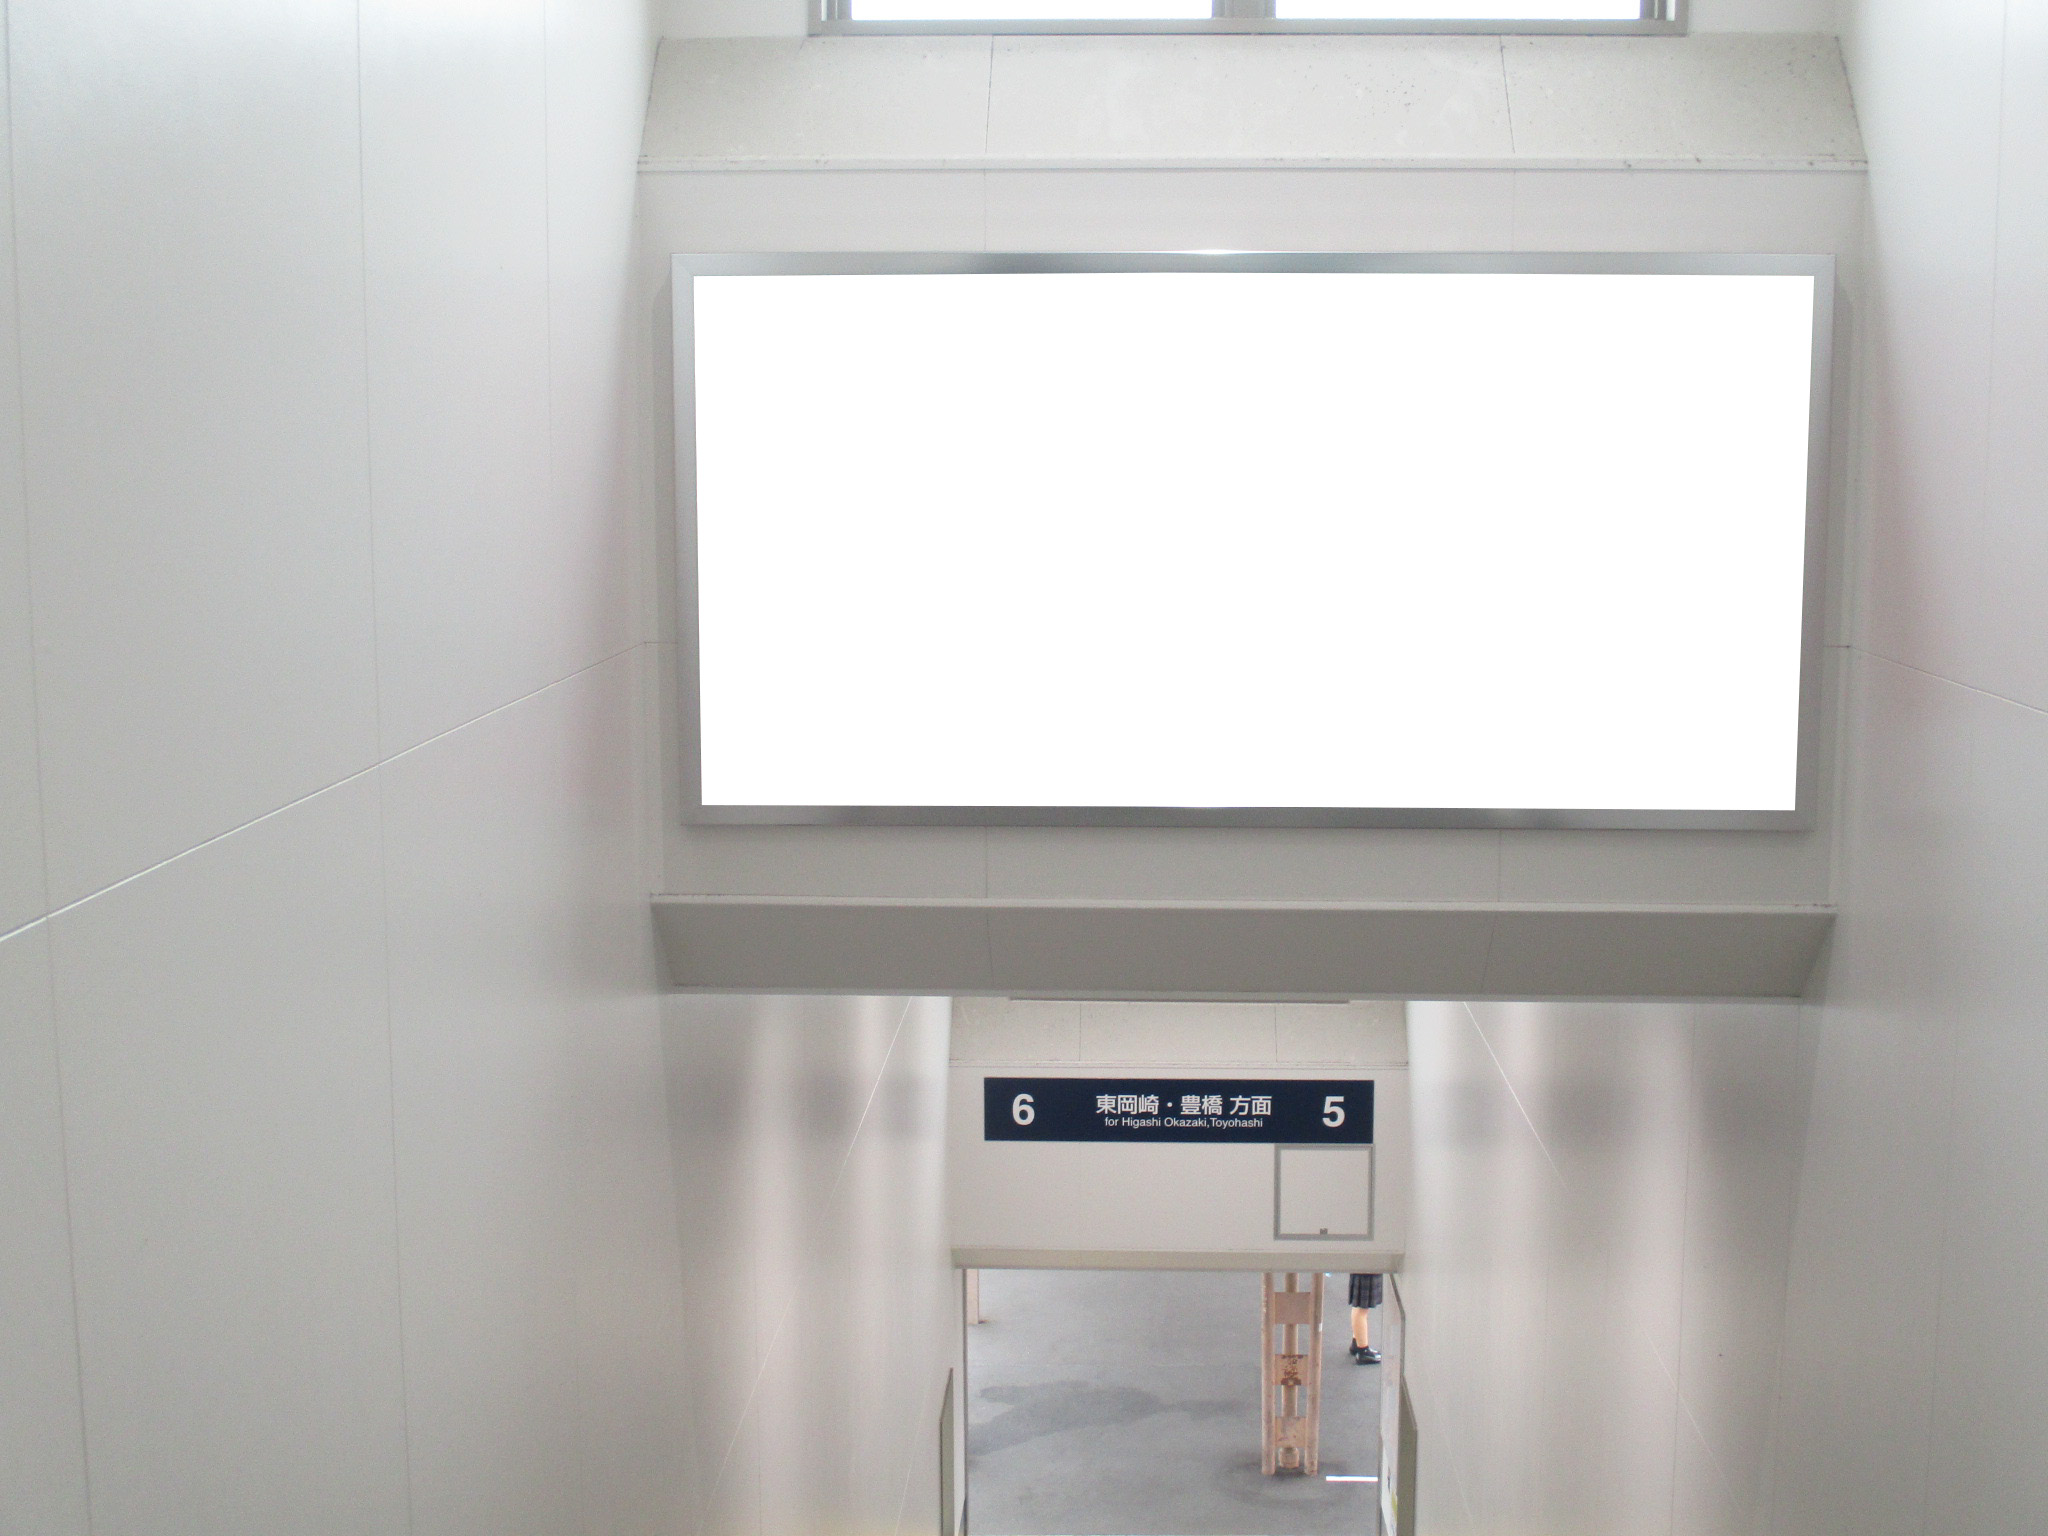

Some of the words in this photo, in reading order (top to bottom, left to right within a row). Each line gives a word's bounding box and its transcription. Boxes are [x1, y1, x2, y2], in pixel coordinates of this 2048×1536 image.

[1012, 1093, 1035, 1126] 6
[1230, 1095, 1272, 1116] 方面
[1322, 1095, 1346, 1128] 5
[1104, 1116, 1119, 1127] for
[1122, 1117, 1161, 1129] Higashi
